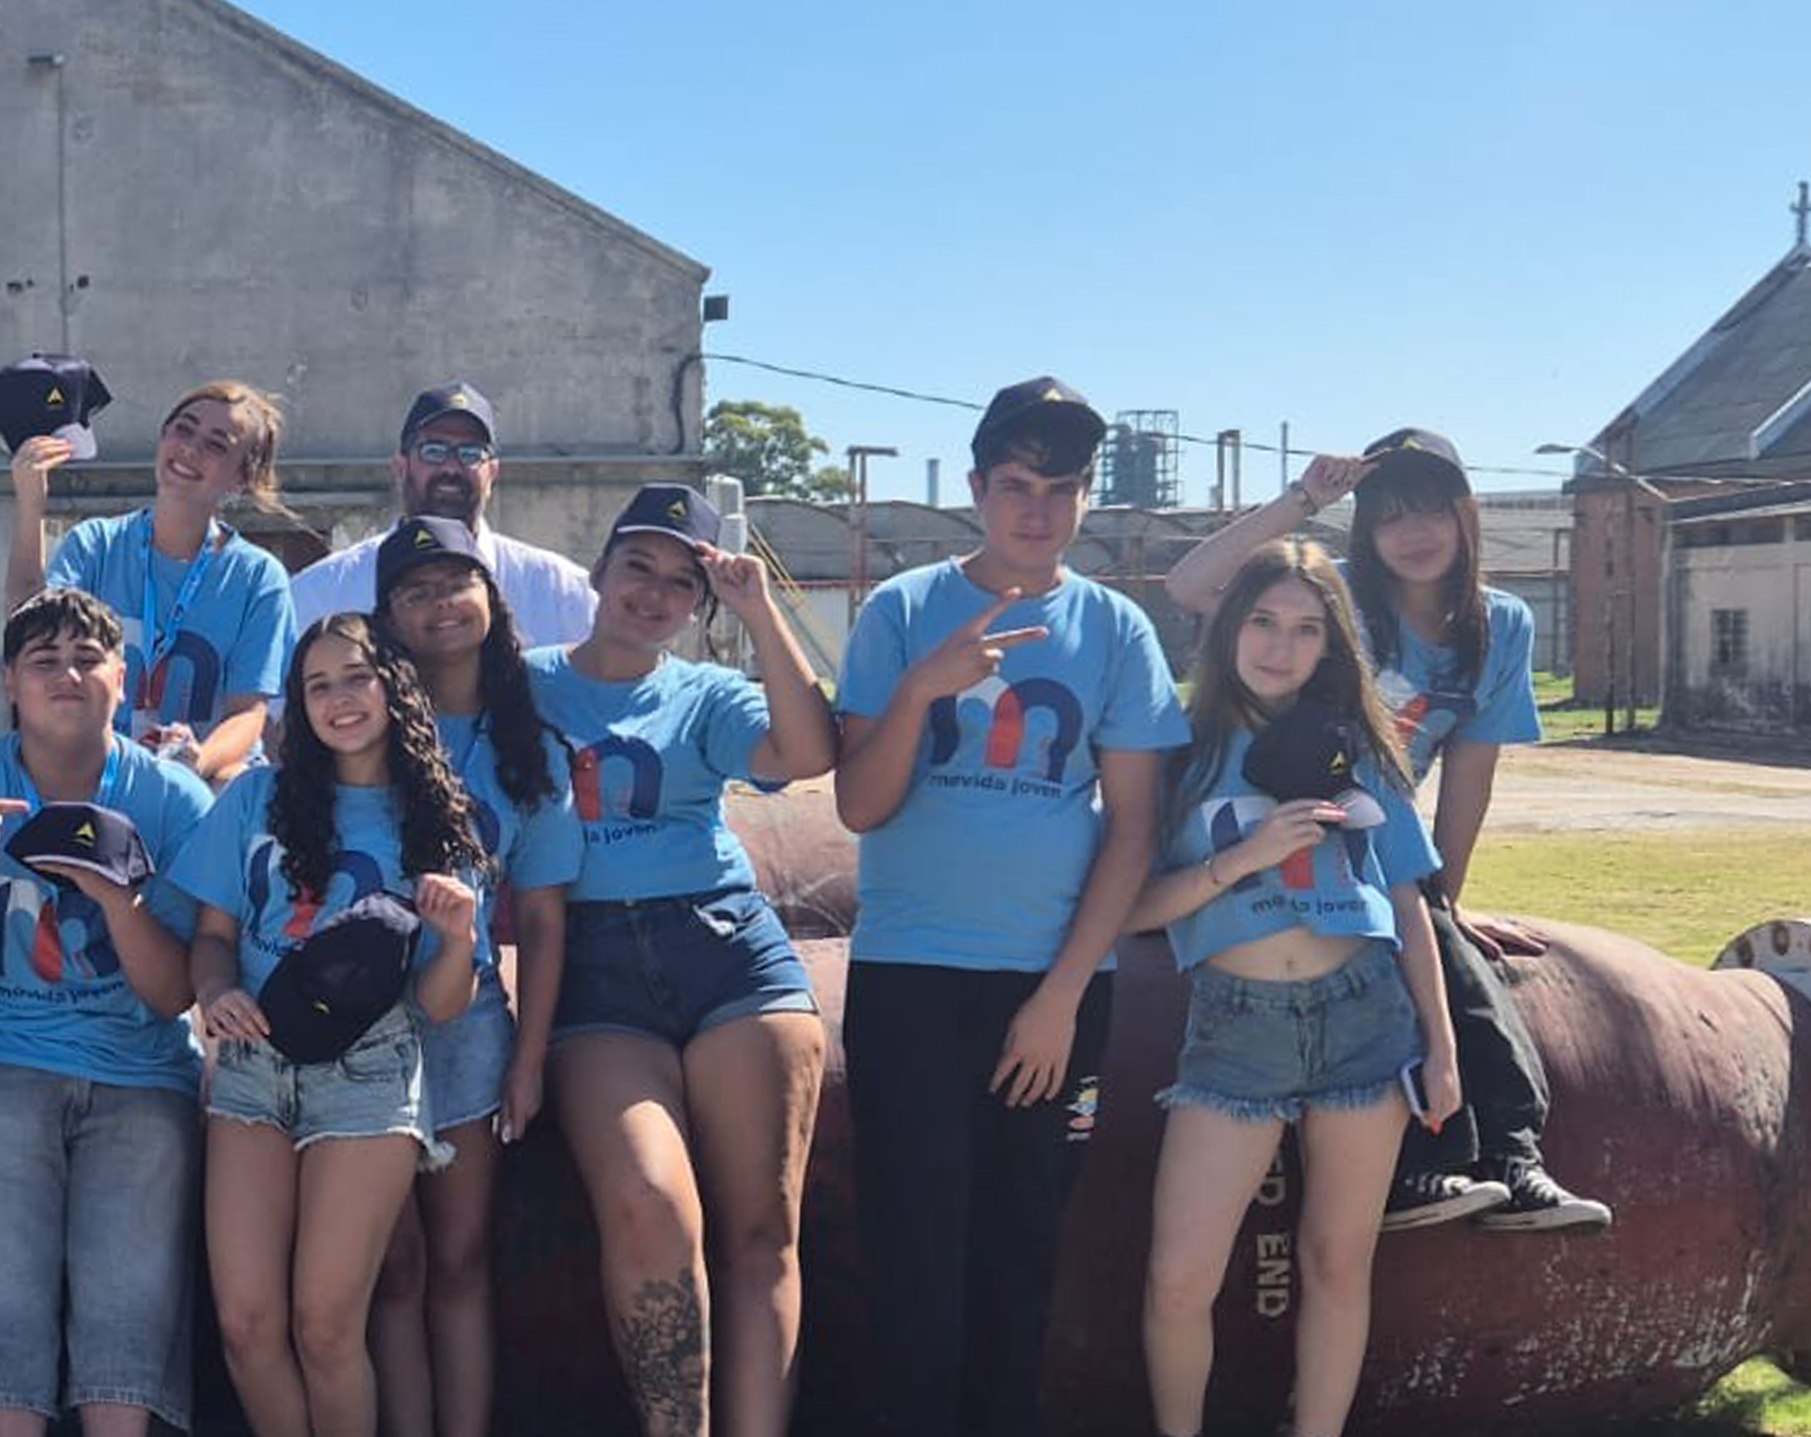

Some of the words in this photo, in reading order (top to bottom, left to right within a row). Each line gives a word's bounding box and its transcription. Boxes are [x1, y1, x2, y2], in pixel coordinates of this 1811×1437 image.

[931, 774, 1006, 792] movida
[1011, 778, 1062, 799] joven
[1256, 1233, 1291, 1318] END
